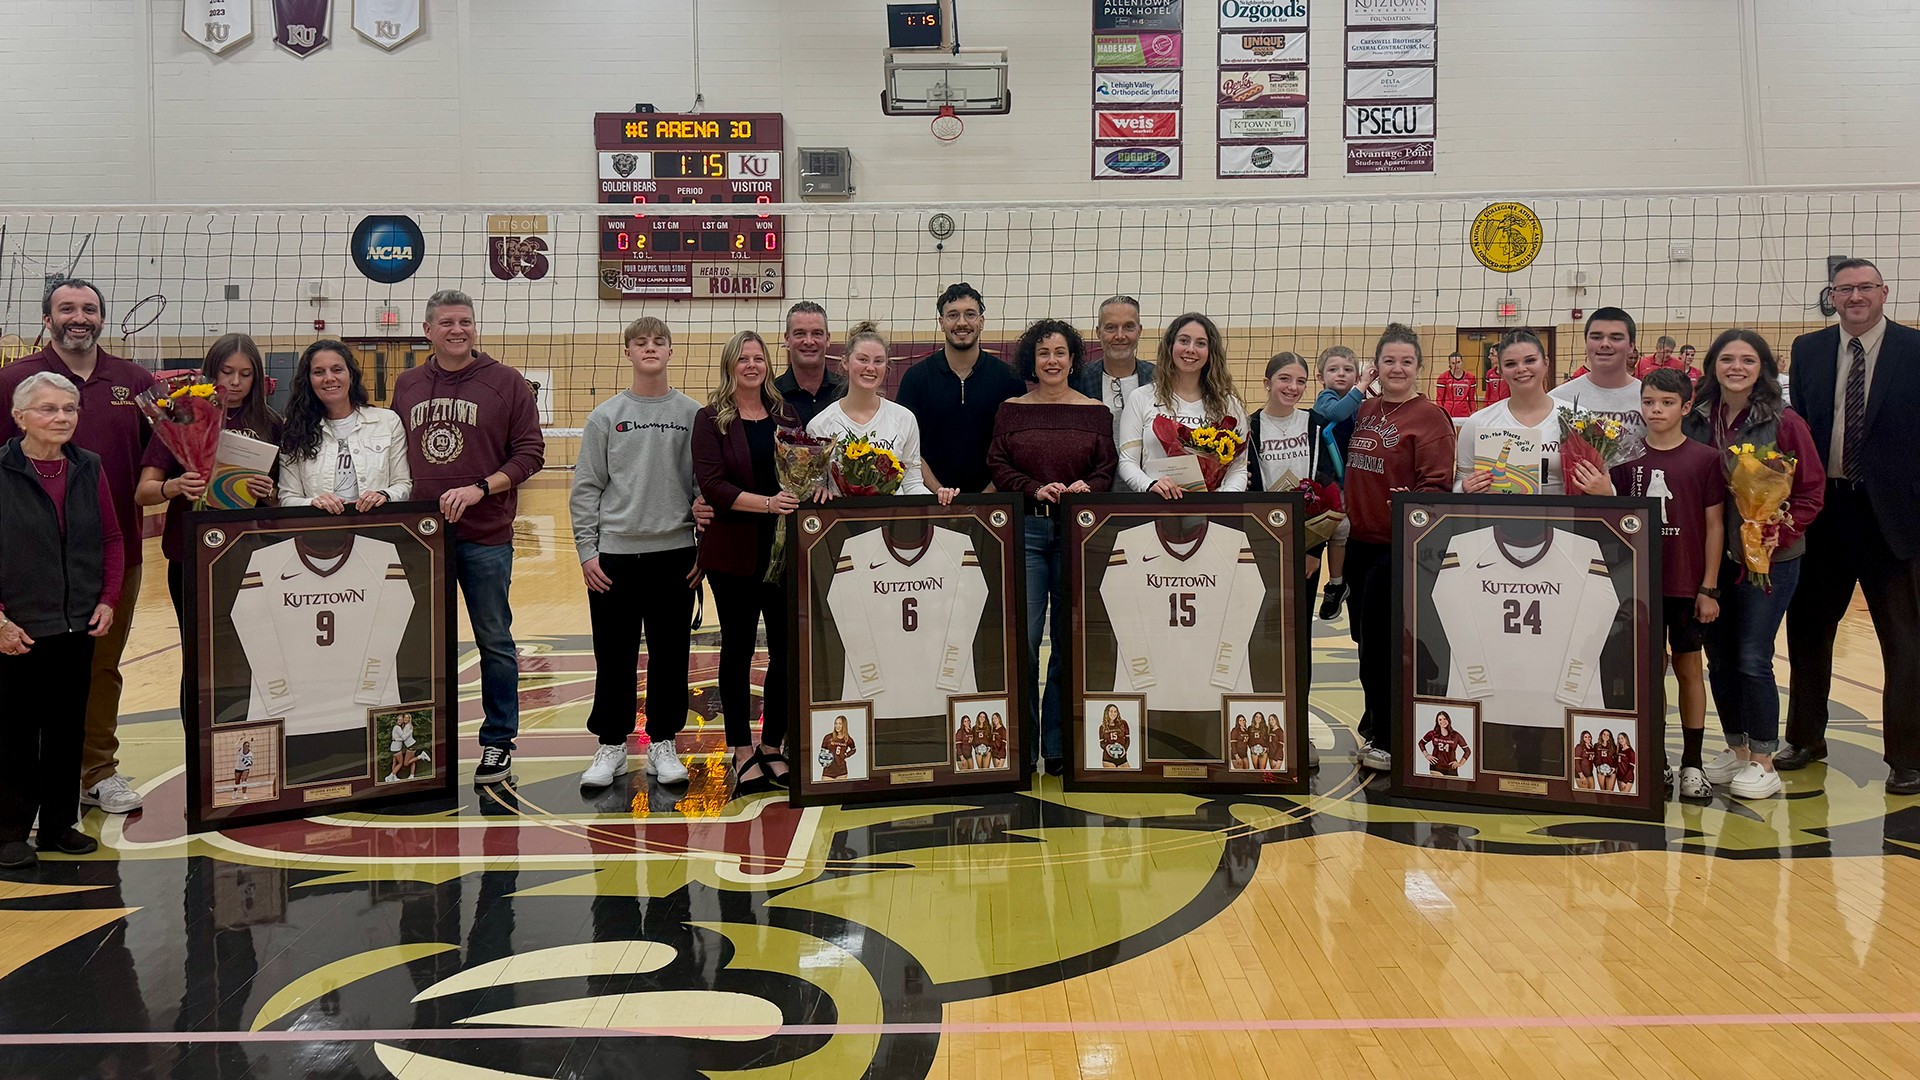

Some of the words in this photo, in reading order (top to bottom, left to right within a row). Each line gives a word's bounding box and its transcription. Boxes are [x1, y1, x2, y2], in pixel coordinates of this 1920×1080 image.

[1222, 0, 1306, 22] Ozgood's
[1355, 0, 1426, 8] KUTZTOWN
[209, 9, 225, 17] 2023
[204, 22, 230, 43] KU
[286, 24, 316, 46] KU
[375, 21, 401, 40] KU
[1097, 45, 1117, 53] MADE
[1118, 44, 1137, 53] EASY
[1244, 36, 1284, 48] UNIQUE
[1112, 115, 1154, 129] weis
[1358, 107, 1416, 134] PSECU
[656, 121, 719, 138] ARENA
[1348, 150, 1403, 160] Advantage
[681, 154, 723, 176] 1:15
[739, 155, 769, 177] KU
[602, 181, 631, 192] GOLDEN
[633, 181, 657, 192] BEARS
[731, 182, 772, 192] VISITOR
[520, 220, 538, 230] ON
[618, 232, 629, 250] 0
[637, 234, 646, 248] 2
[735, 234, 745, 248] 2
[765, 232, 776, 250] 0
[367, 247, 412, 260] NCAA
[489, 236, 549, 280] US
[700, 267, 718, 276] HEAR
[720, 267, 730, 276] US
[616, 274, 637, 290] KU
[710, 278, 757, 294] ROAR!
[1455, 388, 1463, 396] 12
[616, 420, 689, 433] Champion
[1503, 430, 1521, 440] Places
[873, 577, 943, 594] KUTZTOWN
[1147, 574, 1216, 588] KUTZTOWN
[1482, 580, 1561, 596] KUTZTOWN
[283, 589, 365, 608] KUTZTOWN
[902, 598, 918, 632] 6
[1168, 593, 1196, 627] 15
[1503, 599, 1541, 634] 24
[316, 610, 335, 646] 9
[945, 644, 959, 665] ALL
[1218, 642, 1233, 662] ALL
[364, 658, 381, 678] ALL
[860, 662, 879, 683] KU
[942, 668, 954, 678] IN
[1132, 657, 1150, 677] KU
[1216, 665, 1228, 675] IN
[1467, 664, 1487, 685] KU
[1567, 658, 1584, 679] ALL
[268, 678, 290, 700] KU
[362, 680, 376, 691] IN
[1564, 682, 1578, 694] IN
[836, 745, 841, 755] 6
[1438, 742, 1449, 752] 24
